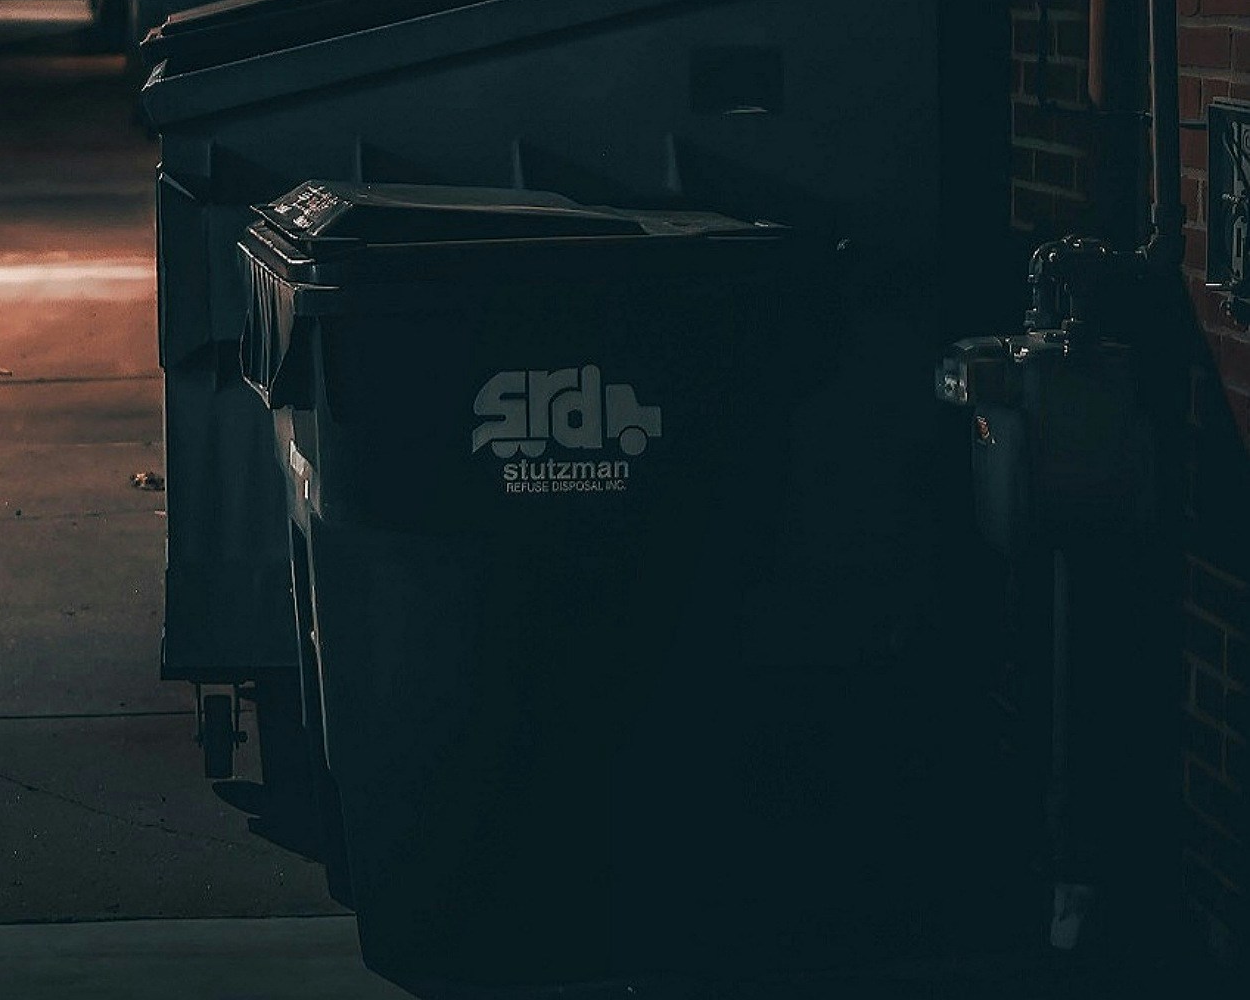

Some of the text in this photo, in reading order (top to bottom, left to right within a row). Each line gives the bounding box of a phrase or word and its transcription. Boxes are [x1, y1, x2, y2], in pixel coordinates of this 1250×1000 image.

[472, 364, 604, 454] srd
[503, 458, 629, 481] stutzman
[506, 481, 550, 493] REFUSE
[552, 481, 604, 492] DISPOSAL
